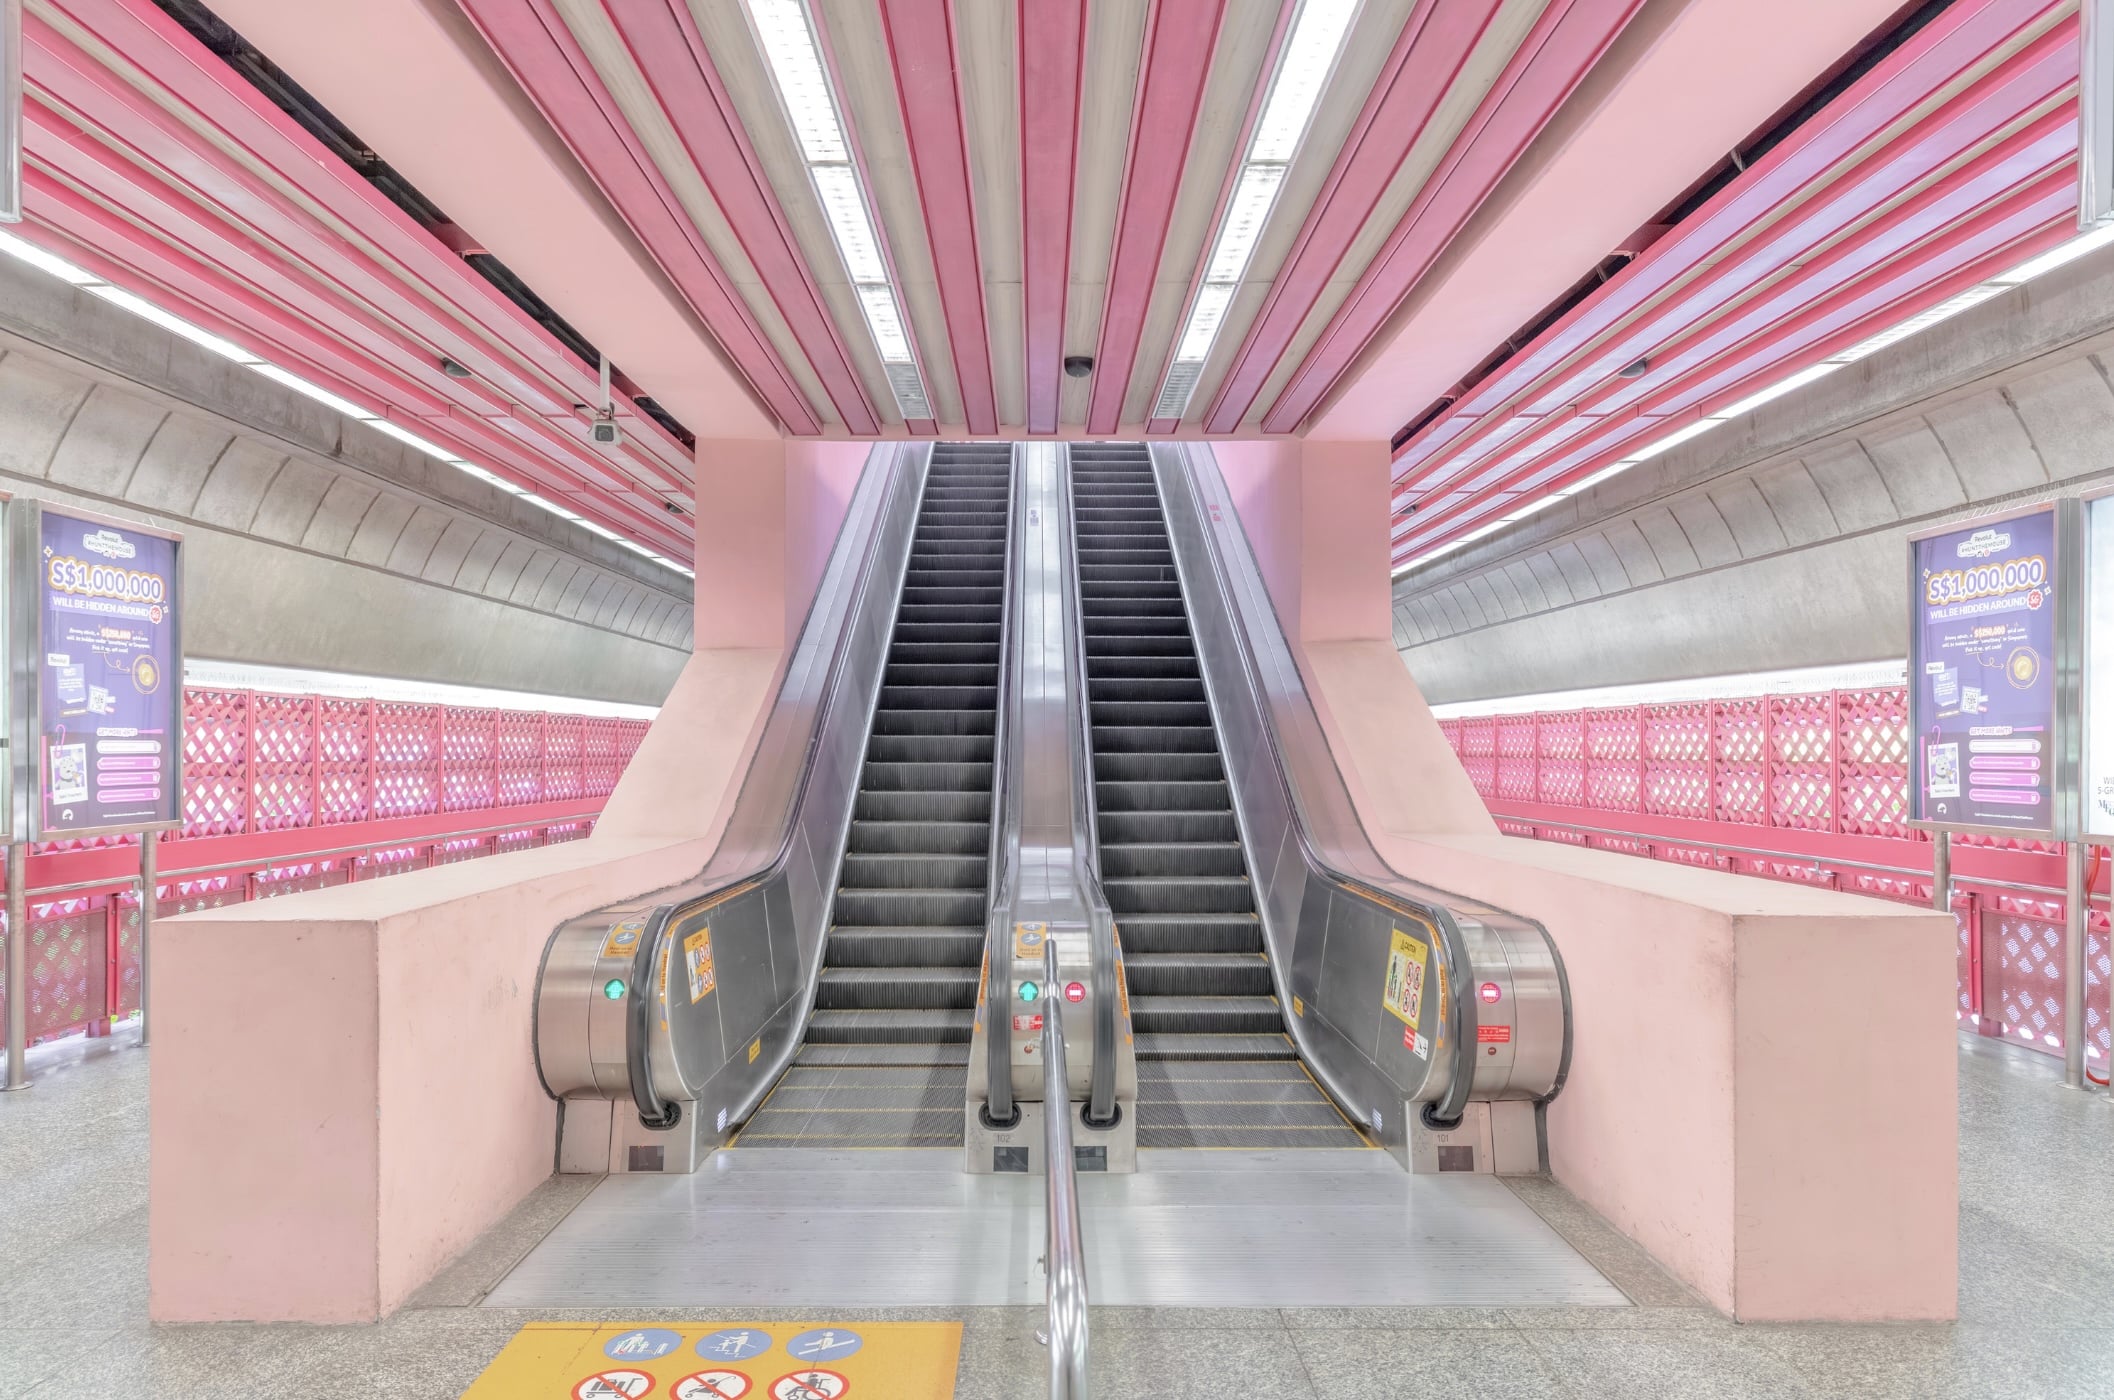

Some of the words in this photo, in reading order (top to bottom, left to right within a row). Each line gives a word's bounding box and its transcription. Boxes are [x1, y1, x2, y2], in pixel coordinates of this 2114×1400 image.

[53, 561, 161, 599] S$1,000,000
[1930, 560, 2042, 599] S$1,000,000
[53, 596, 74, 608] WILL
[75, 600, 86, 609] BE
[86, 601, 116, 613] HIDDEN
[116, 605, 149, 617] AROUND
[1930, 609, 1948, 619] WILL
[1949, 607, 1959, 616] BE
[1960, 603, 1990, 615] HIDDEN
[1991, 597, 2026, 610] AROUND
[997, 1134, 1011, 1143] 102
[1437, 1134, 1449, 1143] 101
